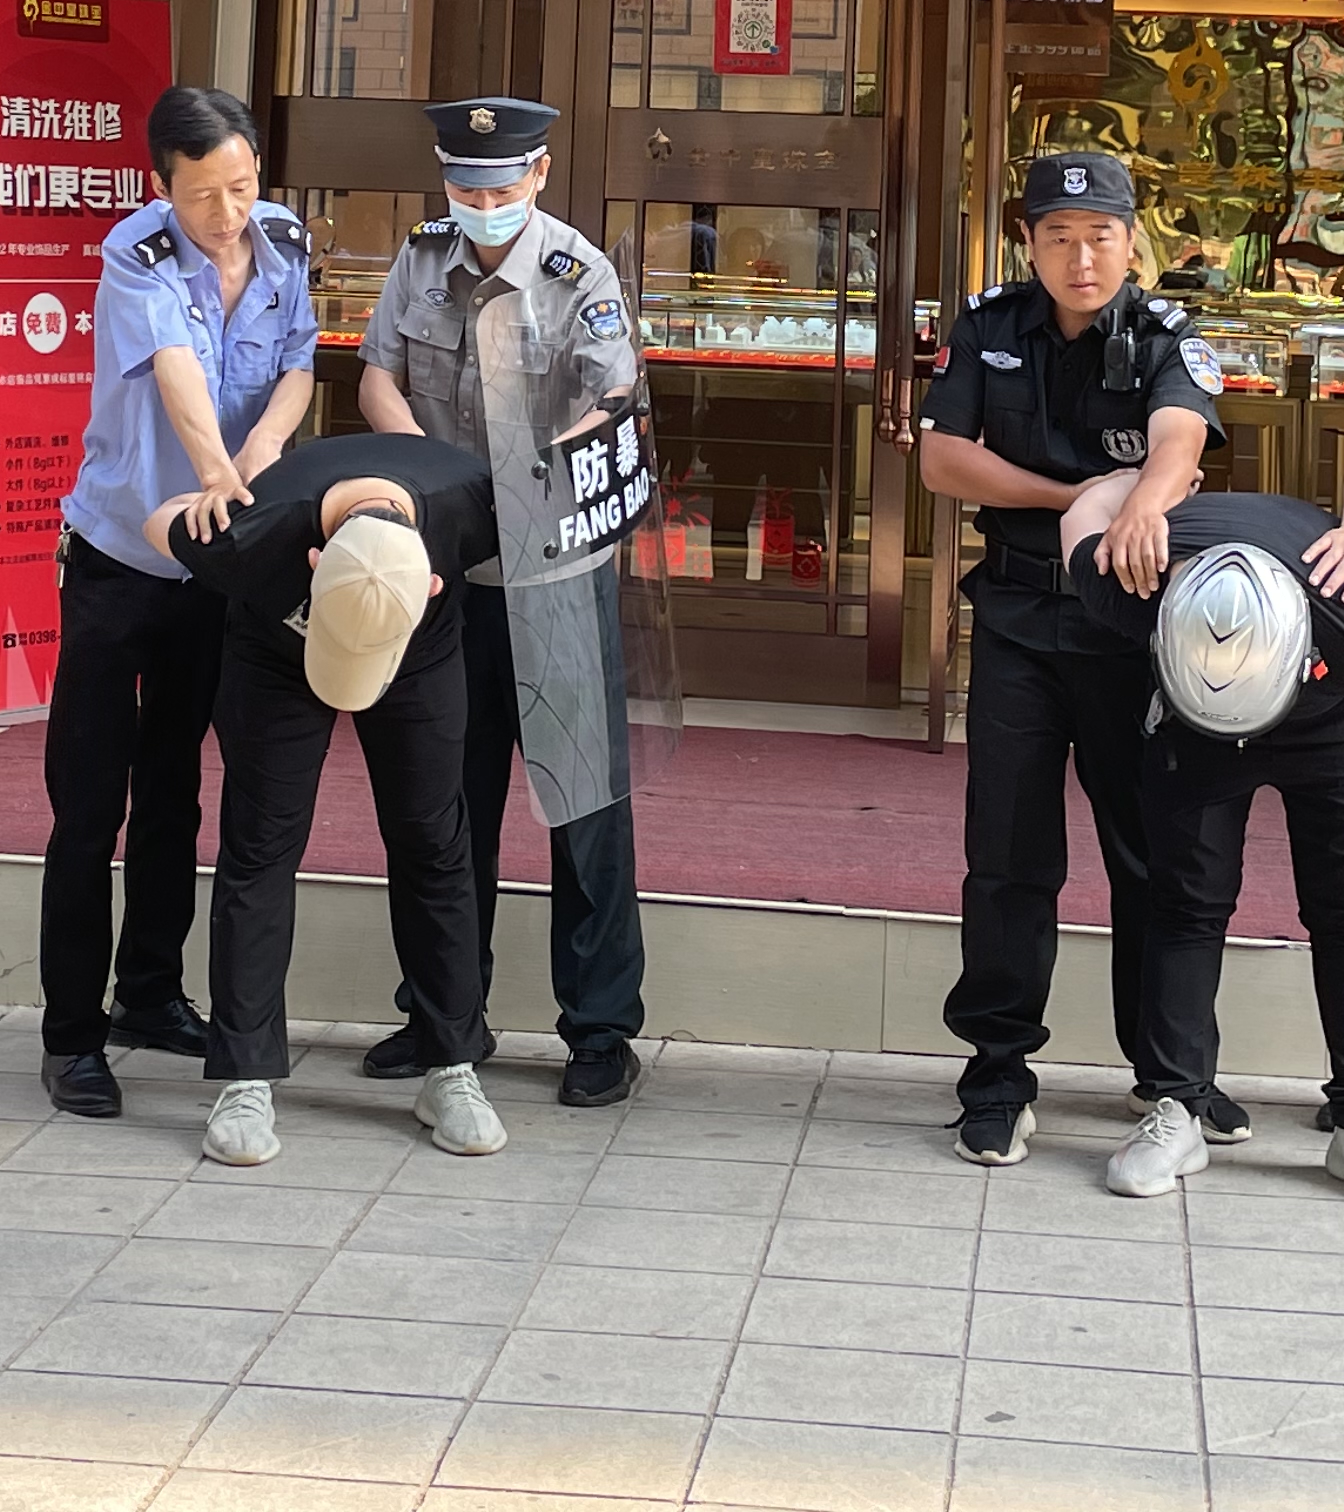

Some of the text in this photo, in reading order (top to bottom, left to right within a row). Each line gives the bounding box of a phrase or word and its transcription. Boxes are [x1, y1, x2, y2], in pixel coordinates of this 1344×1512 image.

[0, 94, 123, 141] 清洗维修
[26, 311, 63, 336] 免费
[570, 414, 640, 505] 防暴
[558, 466, 650, 553] FANG BAO
